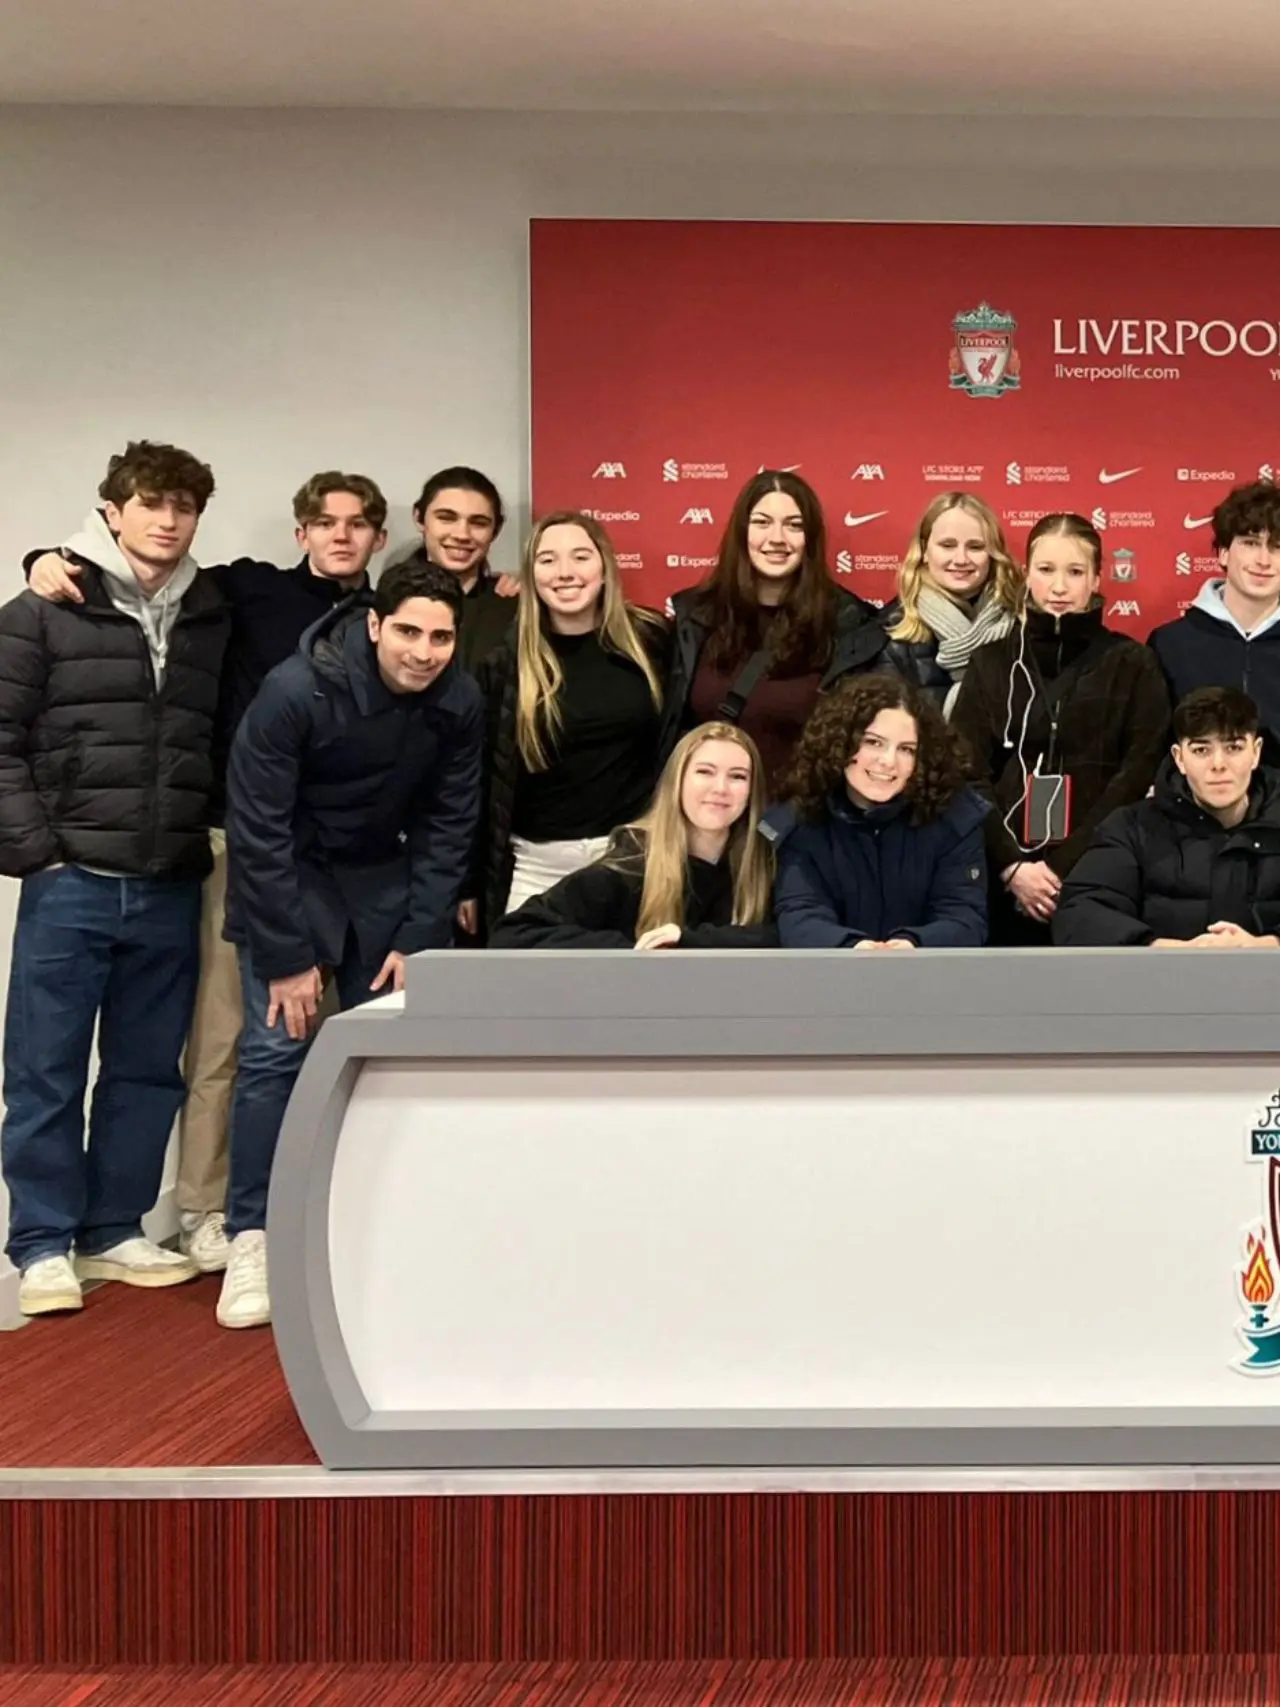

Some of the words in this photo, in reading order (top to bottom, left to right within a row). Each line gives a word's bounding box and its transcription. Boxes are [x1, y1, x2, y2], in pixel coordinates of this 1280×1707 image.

[1054, 363, 1180, 382] liverpoolfc.com
[591, 461, 628, 479] AXA
[681, 463, 726, 471] standard
[850, 463, 885, 480] AXA
[1024, 466, 1068, 474] standard
[681, 470, 729, 479] chartered
[1024, 473, 1070, 482] chartered
[1190, 469, 1235, 482] Expedia
[593, 509, 640, 522] Expedia
[679, 507, 715, 524] AXA
[1107, 600, 1141, 616] AXA
